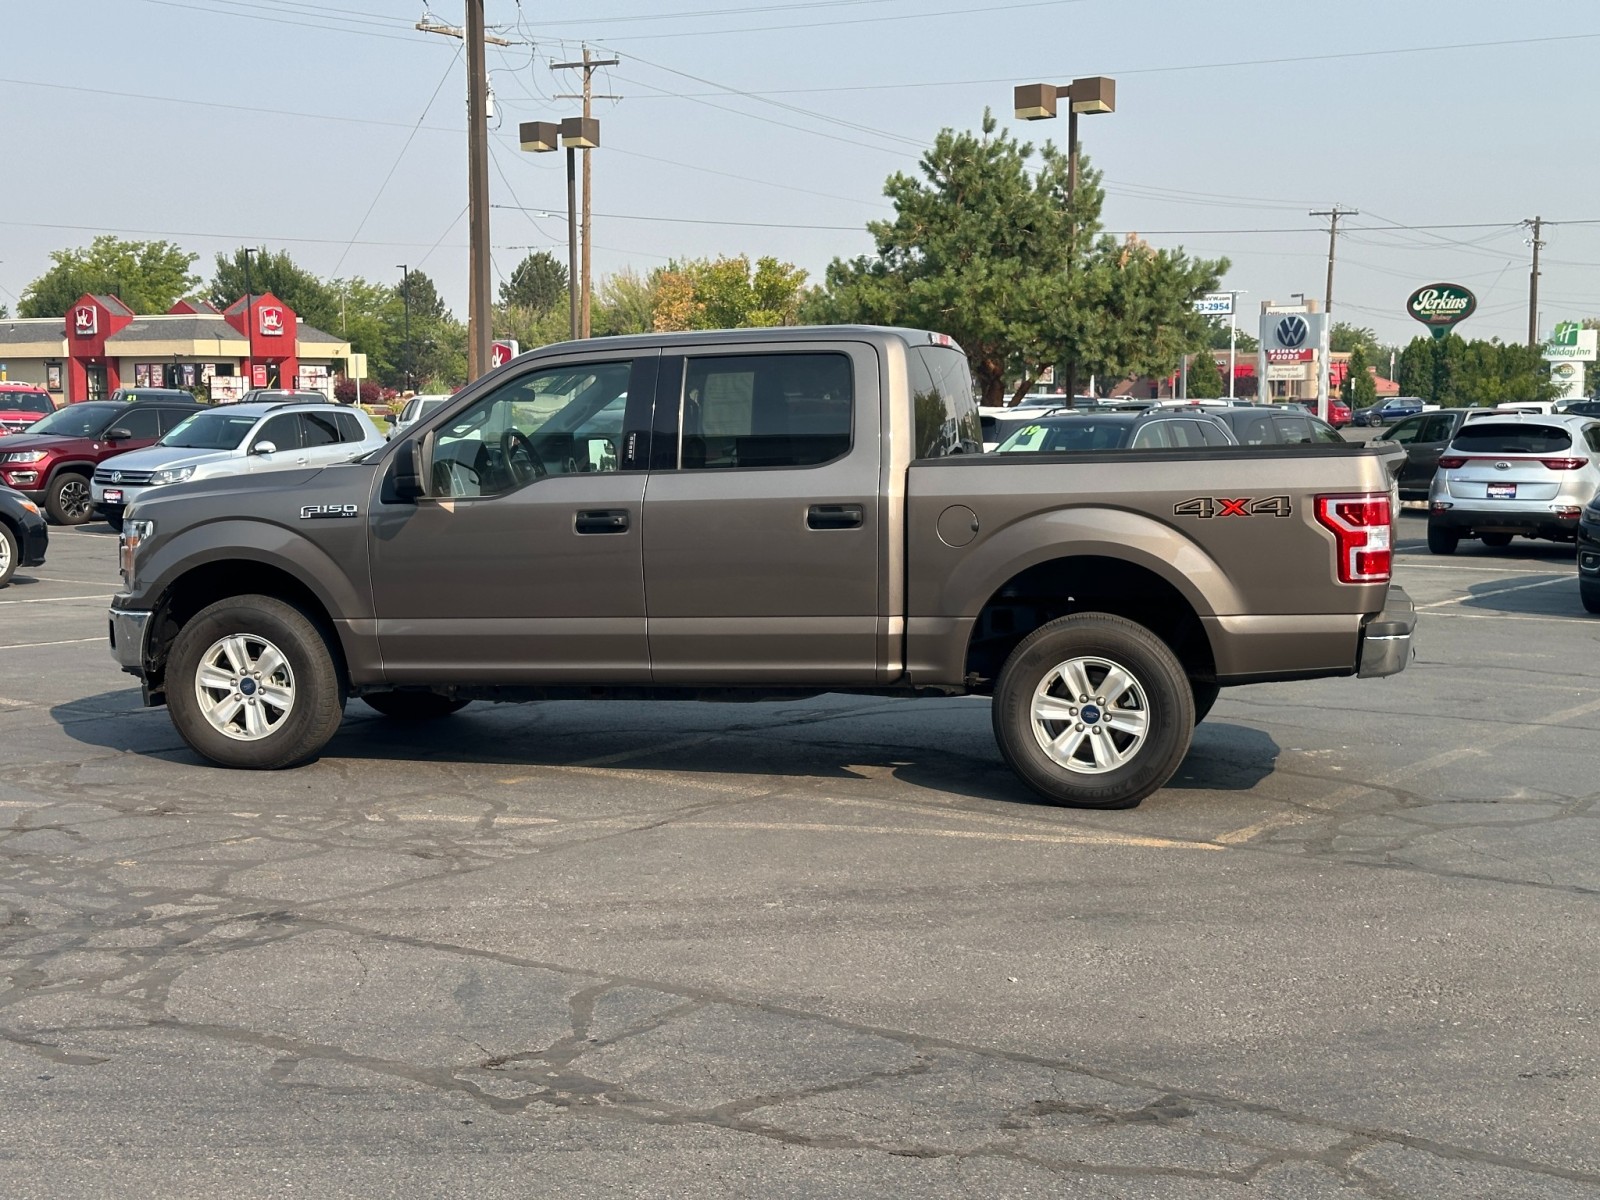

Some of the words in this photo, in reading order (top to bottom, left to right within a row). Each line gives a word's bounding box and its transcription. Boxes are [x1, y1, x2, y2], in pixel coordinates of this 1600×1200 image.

[1413, 288, 1468, 311] Perkins
[75, 309, 93, 327] Jack
[262, 310, 283, 328] Jack
[492, 346, 504, 369] ck
[1576, 346, 1591, 356] Inn
